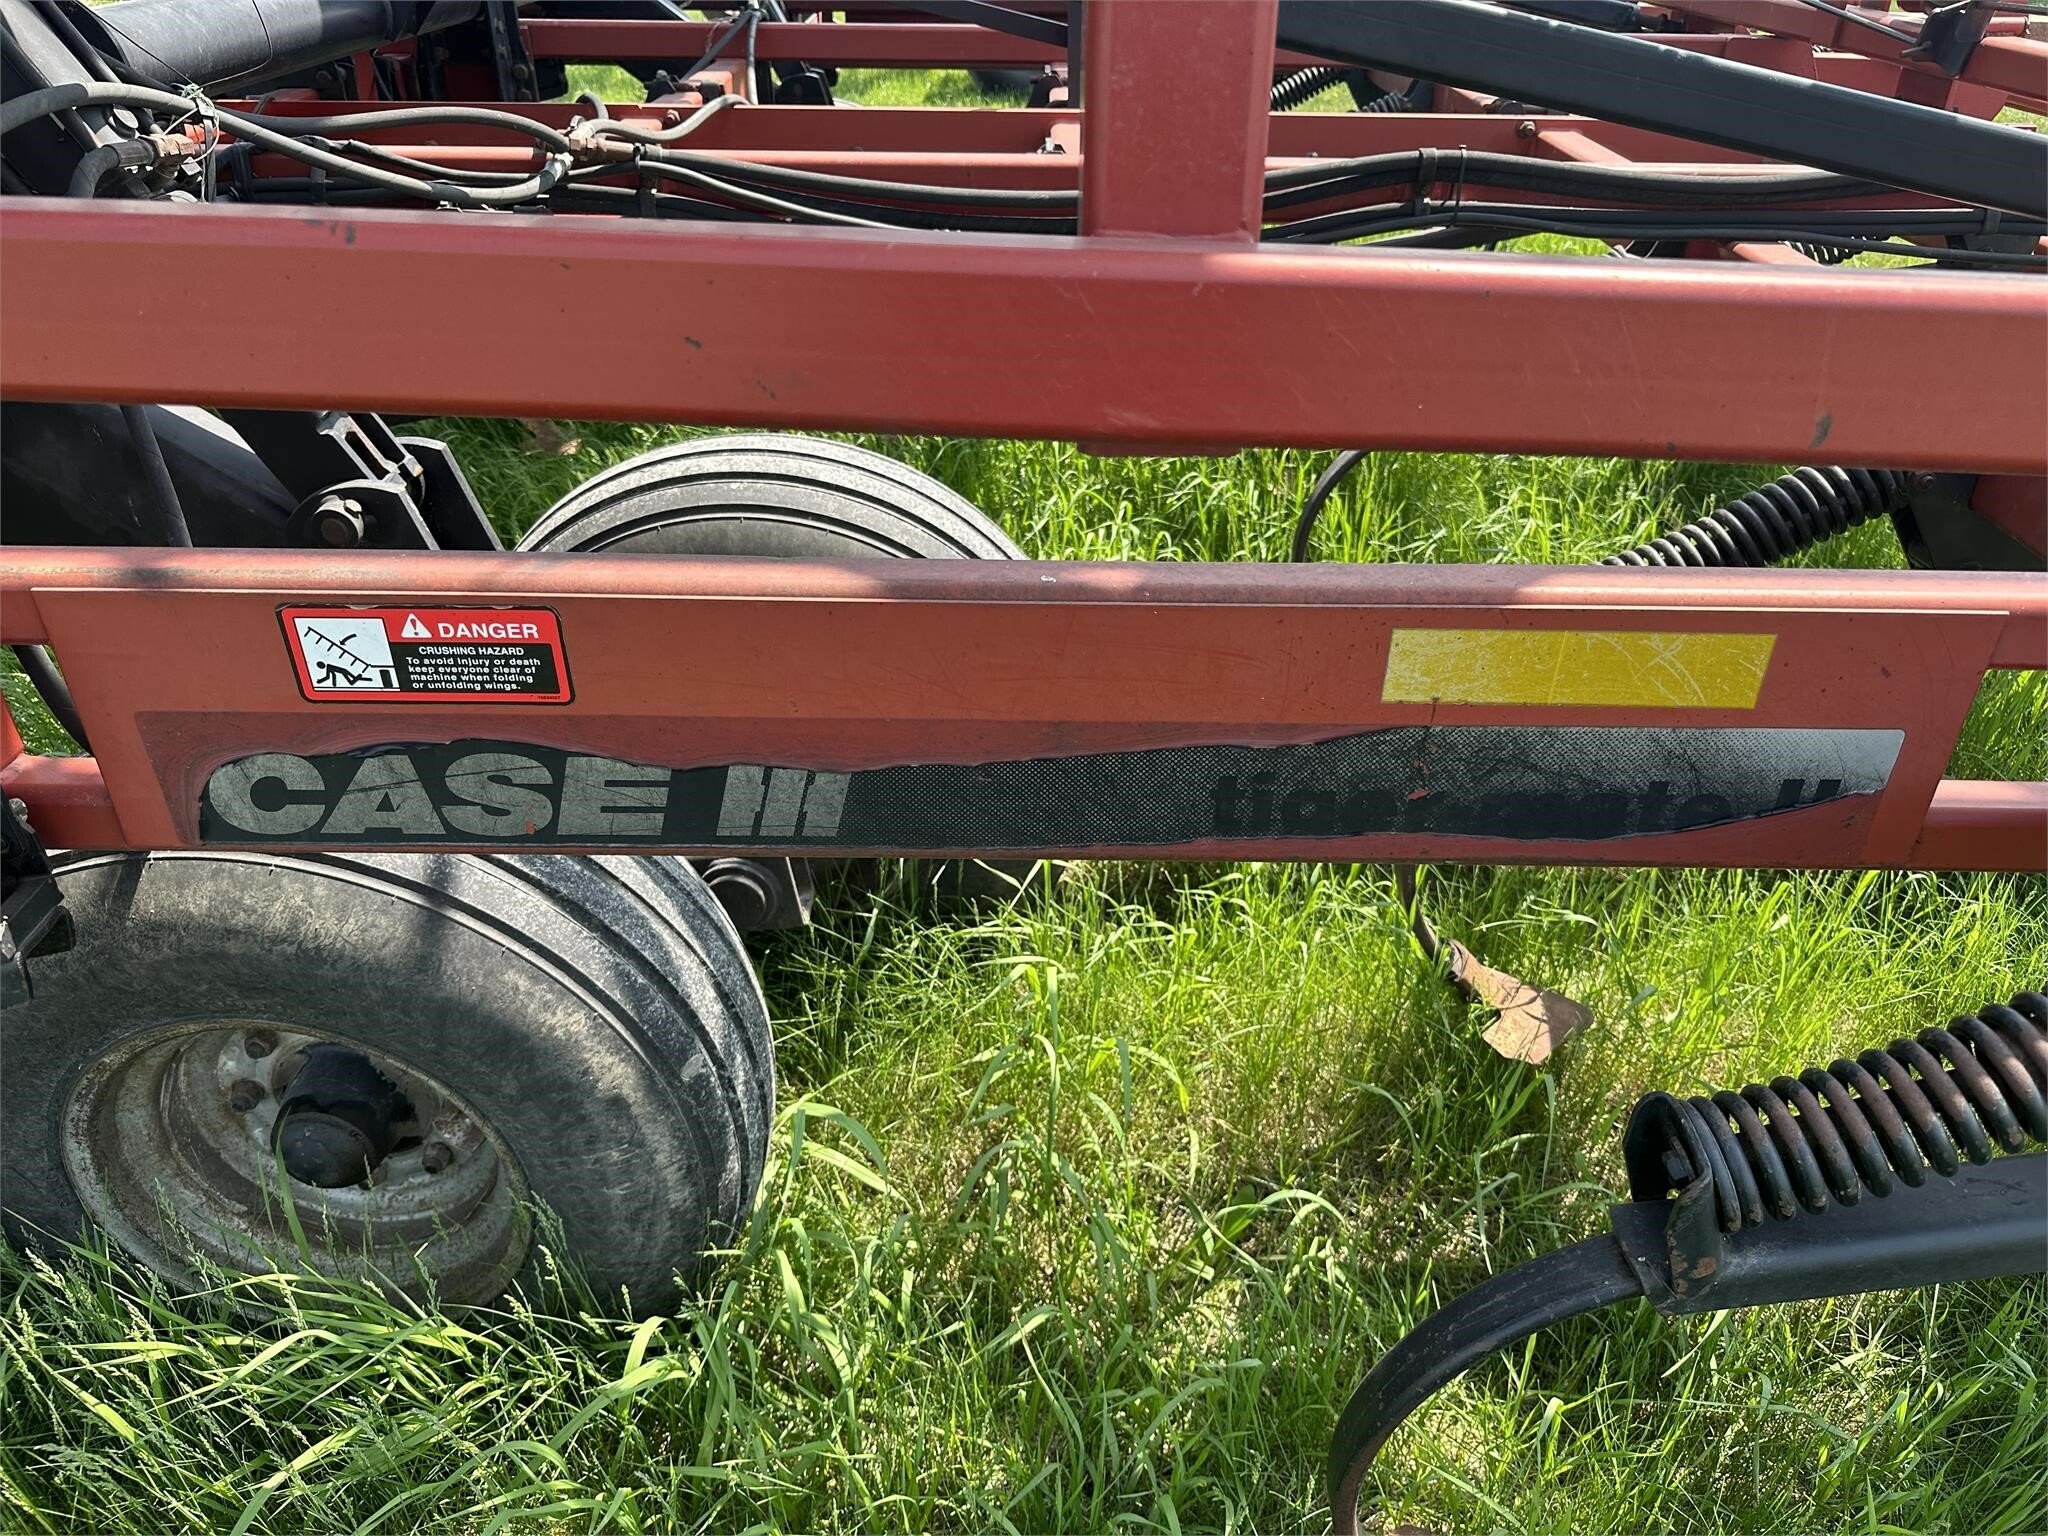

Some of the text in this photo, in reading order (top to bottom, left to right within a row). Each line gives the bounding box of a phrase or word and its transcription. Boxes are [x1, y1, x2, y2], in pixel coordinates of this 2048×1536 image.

[437, 623, 540, 639] DANGER
[418, 646, 524, 656] CRUSHING HAZARD
[406, 657, 419, 665] To
[423, 657, 454, 665] avoid
[457, 657, 490, 667] injury
[509, 658, 541, 666] death
[408, 665, 537, 675] keep everyone clear of
[410, 673, 457, 681] machine
[493, 674, 533, 683] folding
[427, 681, 481, 691] unfolding
[484, 682, 521, 691] wings.
[208, 752, 671, 837] CASE
